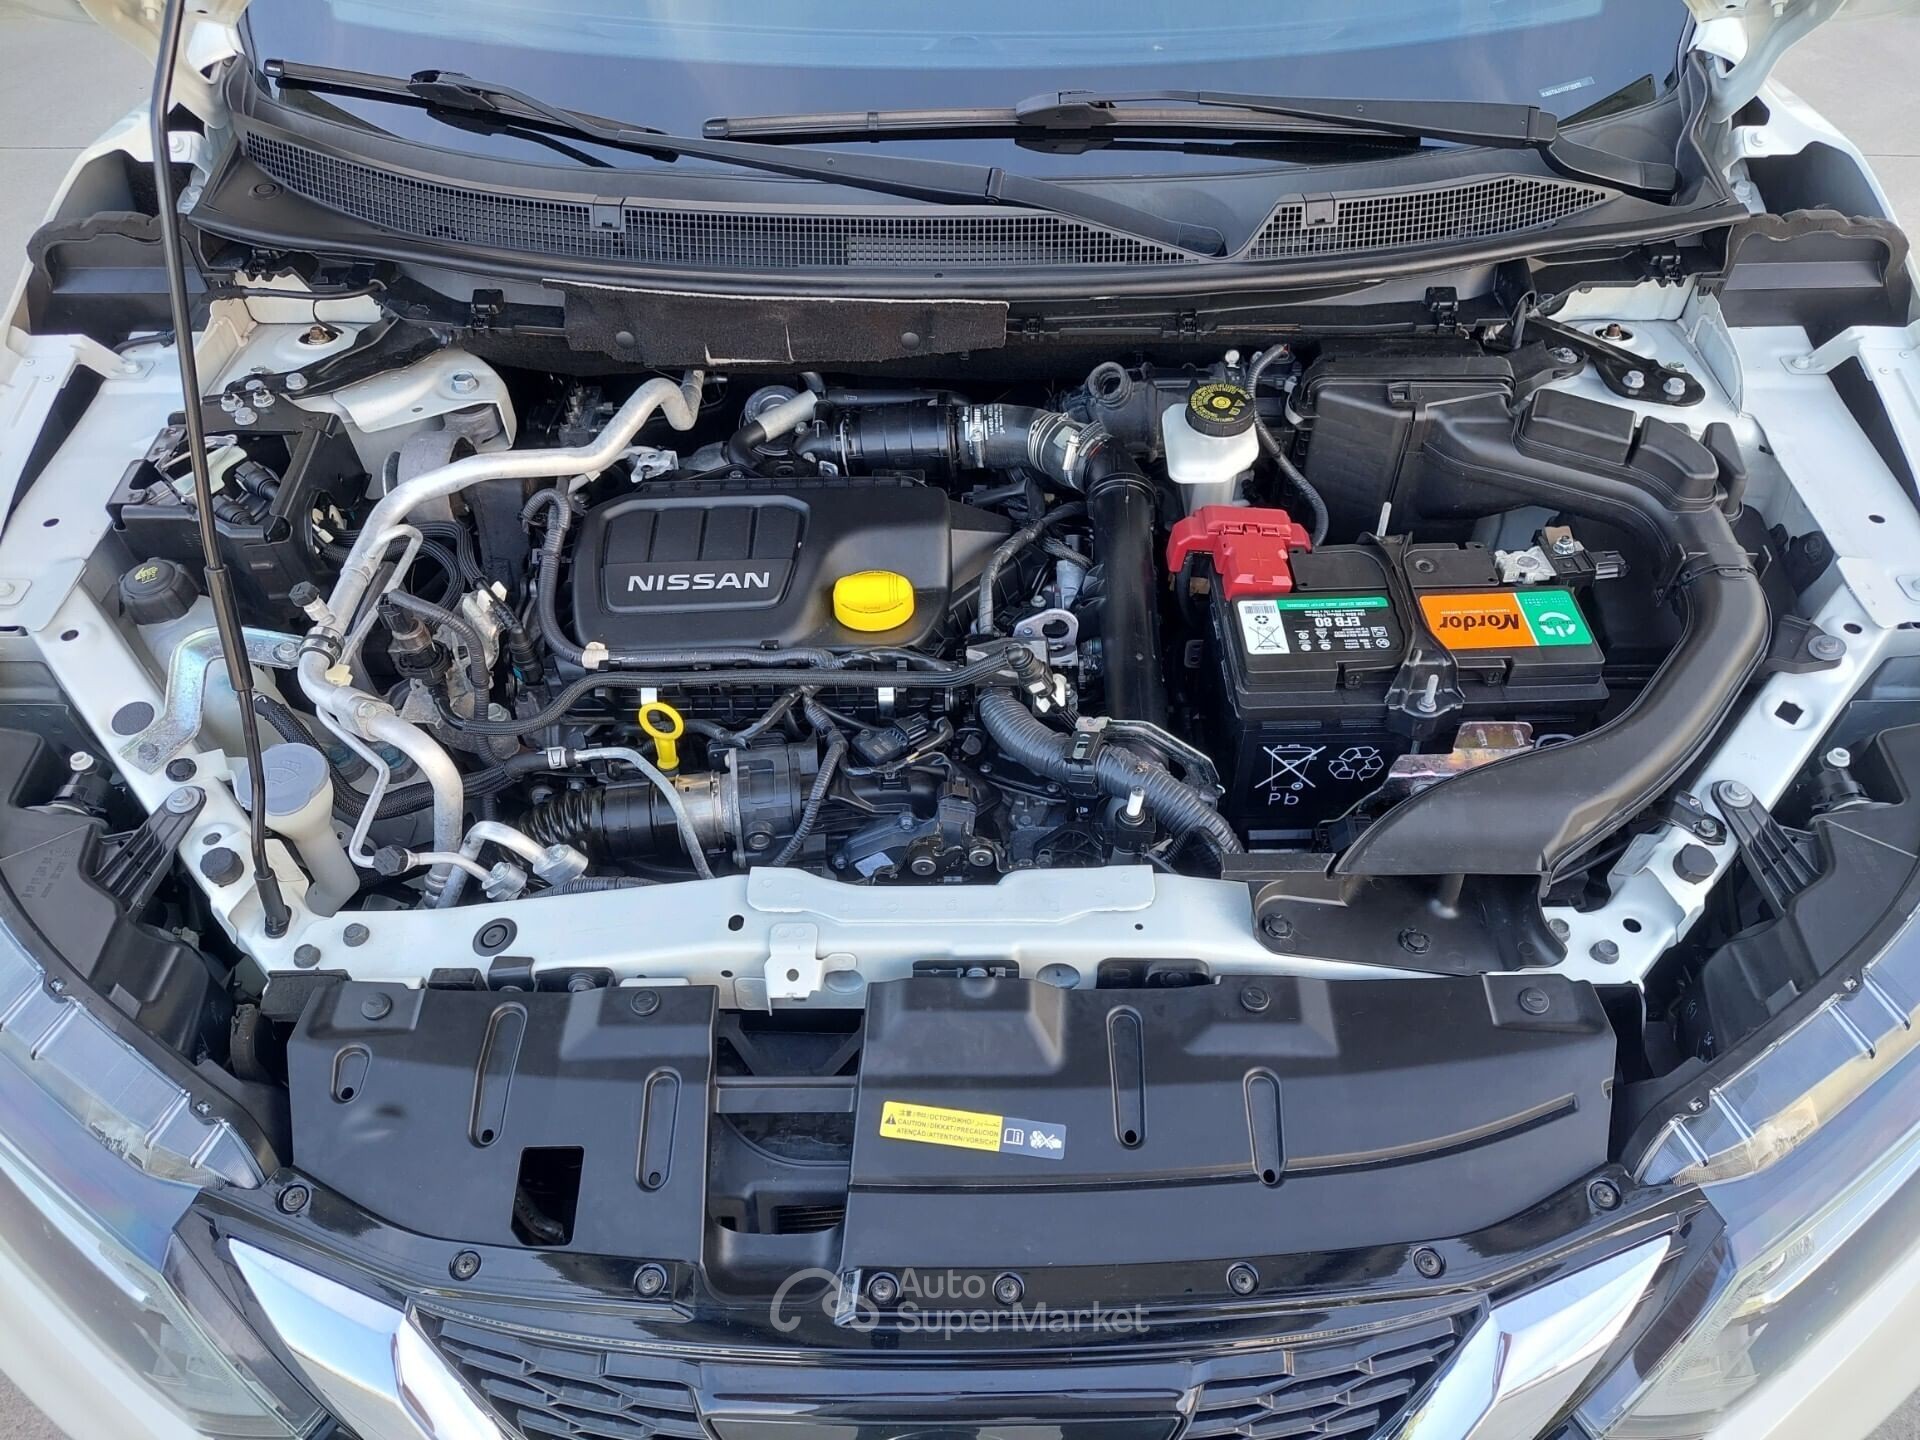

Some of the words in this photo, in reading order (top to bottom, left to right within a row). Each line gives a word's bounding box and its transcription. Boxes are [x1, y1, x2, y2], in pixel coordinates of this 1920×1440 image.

[627, 572, 770, 592] NISSAN
[1314, 617, 1333, 627] 80
[1334, 617, 1361, 627] EFB
[1439, 614, 1520, 631] Nordor
[1268, 792, 1299, 805] Pb
